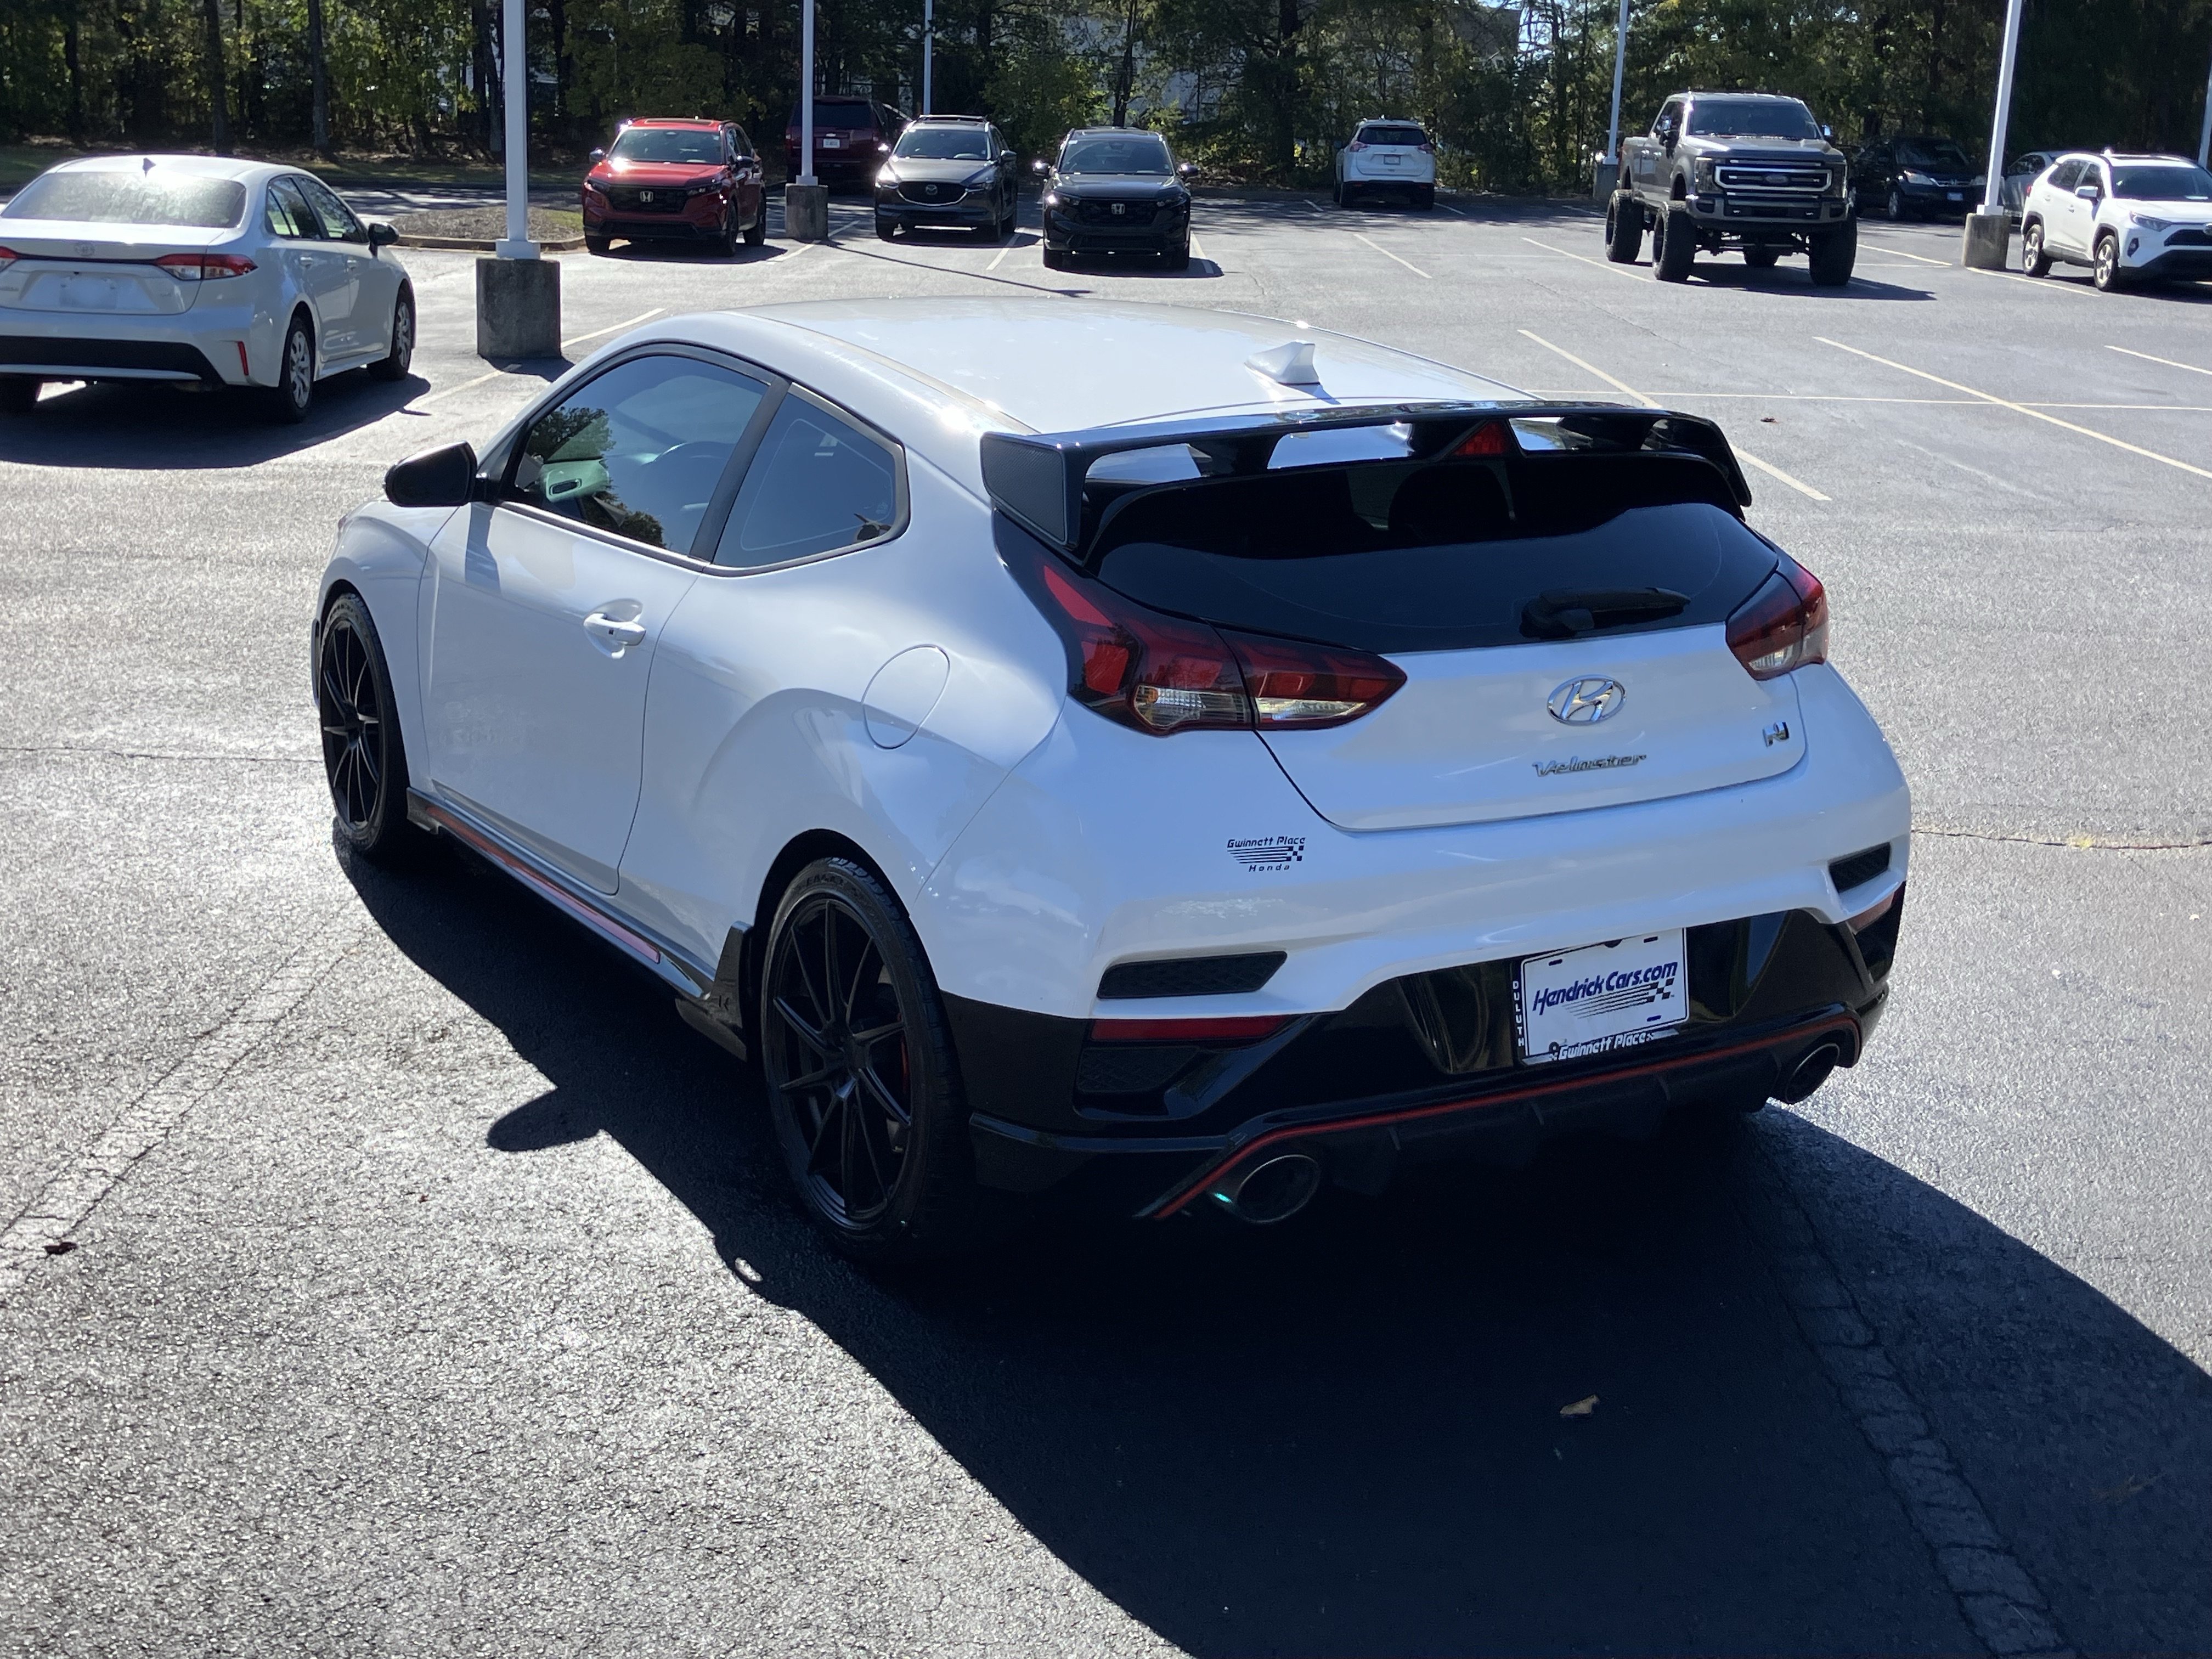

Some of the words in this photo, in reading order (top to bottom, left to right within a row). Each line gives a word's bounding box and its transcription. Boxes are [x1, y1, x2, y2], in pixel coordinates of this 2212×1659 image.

[1532, 754, 1647, 777] Veloster
[1227, 837, 1273, 848] Gwinnett
[1276, 836, 1306, 845] Place
[1248, 864, 1290, 872] Honda
[1512, 980, 1525, 1047] DULUTH
[1559, 1036, 1613, 1060] Gwinnett
[1614, 1031, 1646, 1049] Place
